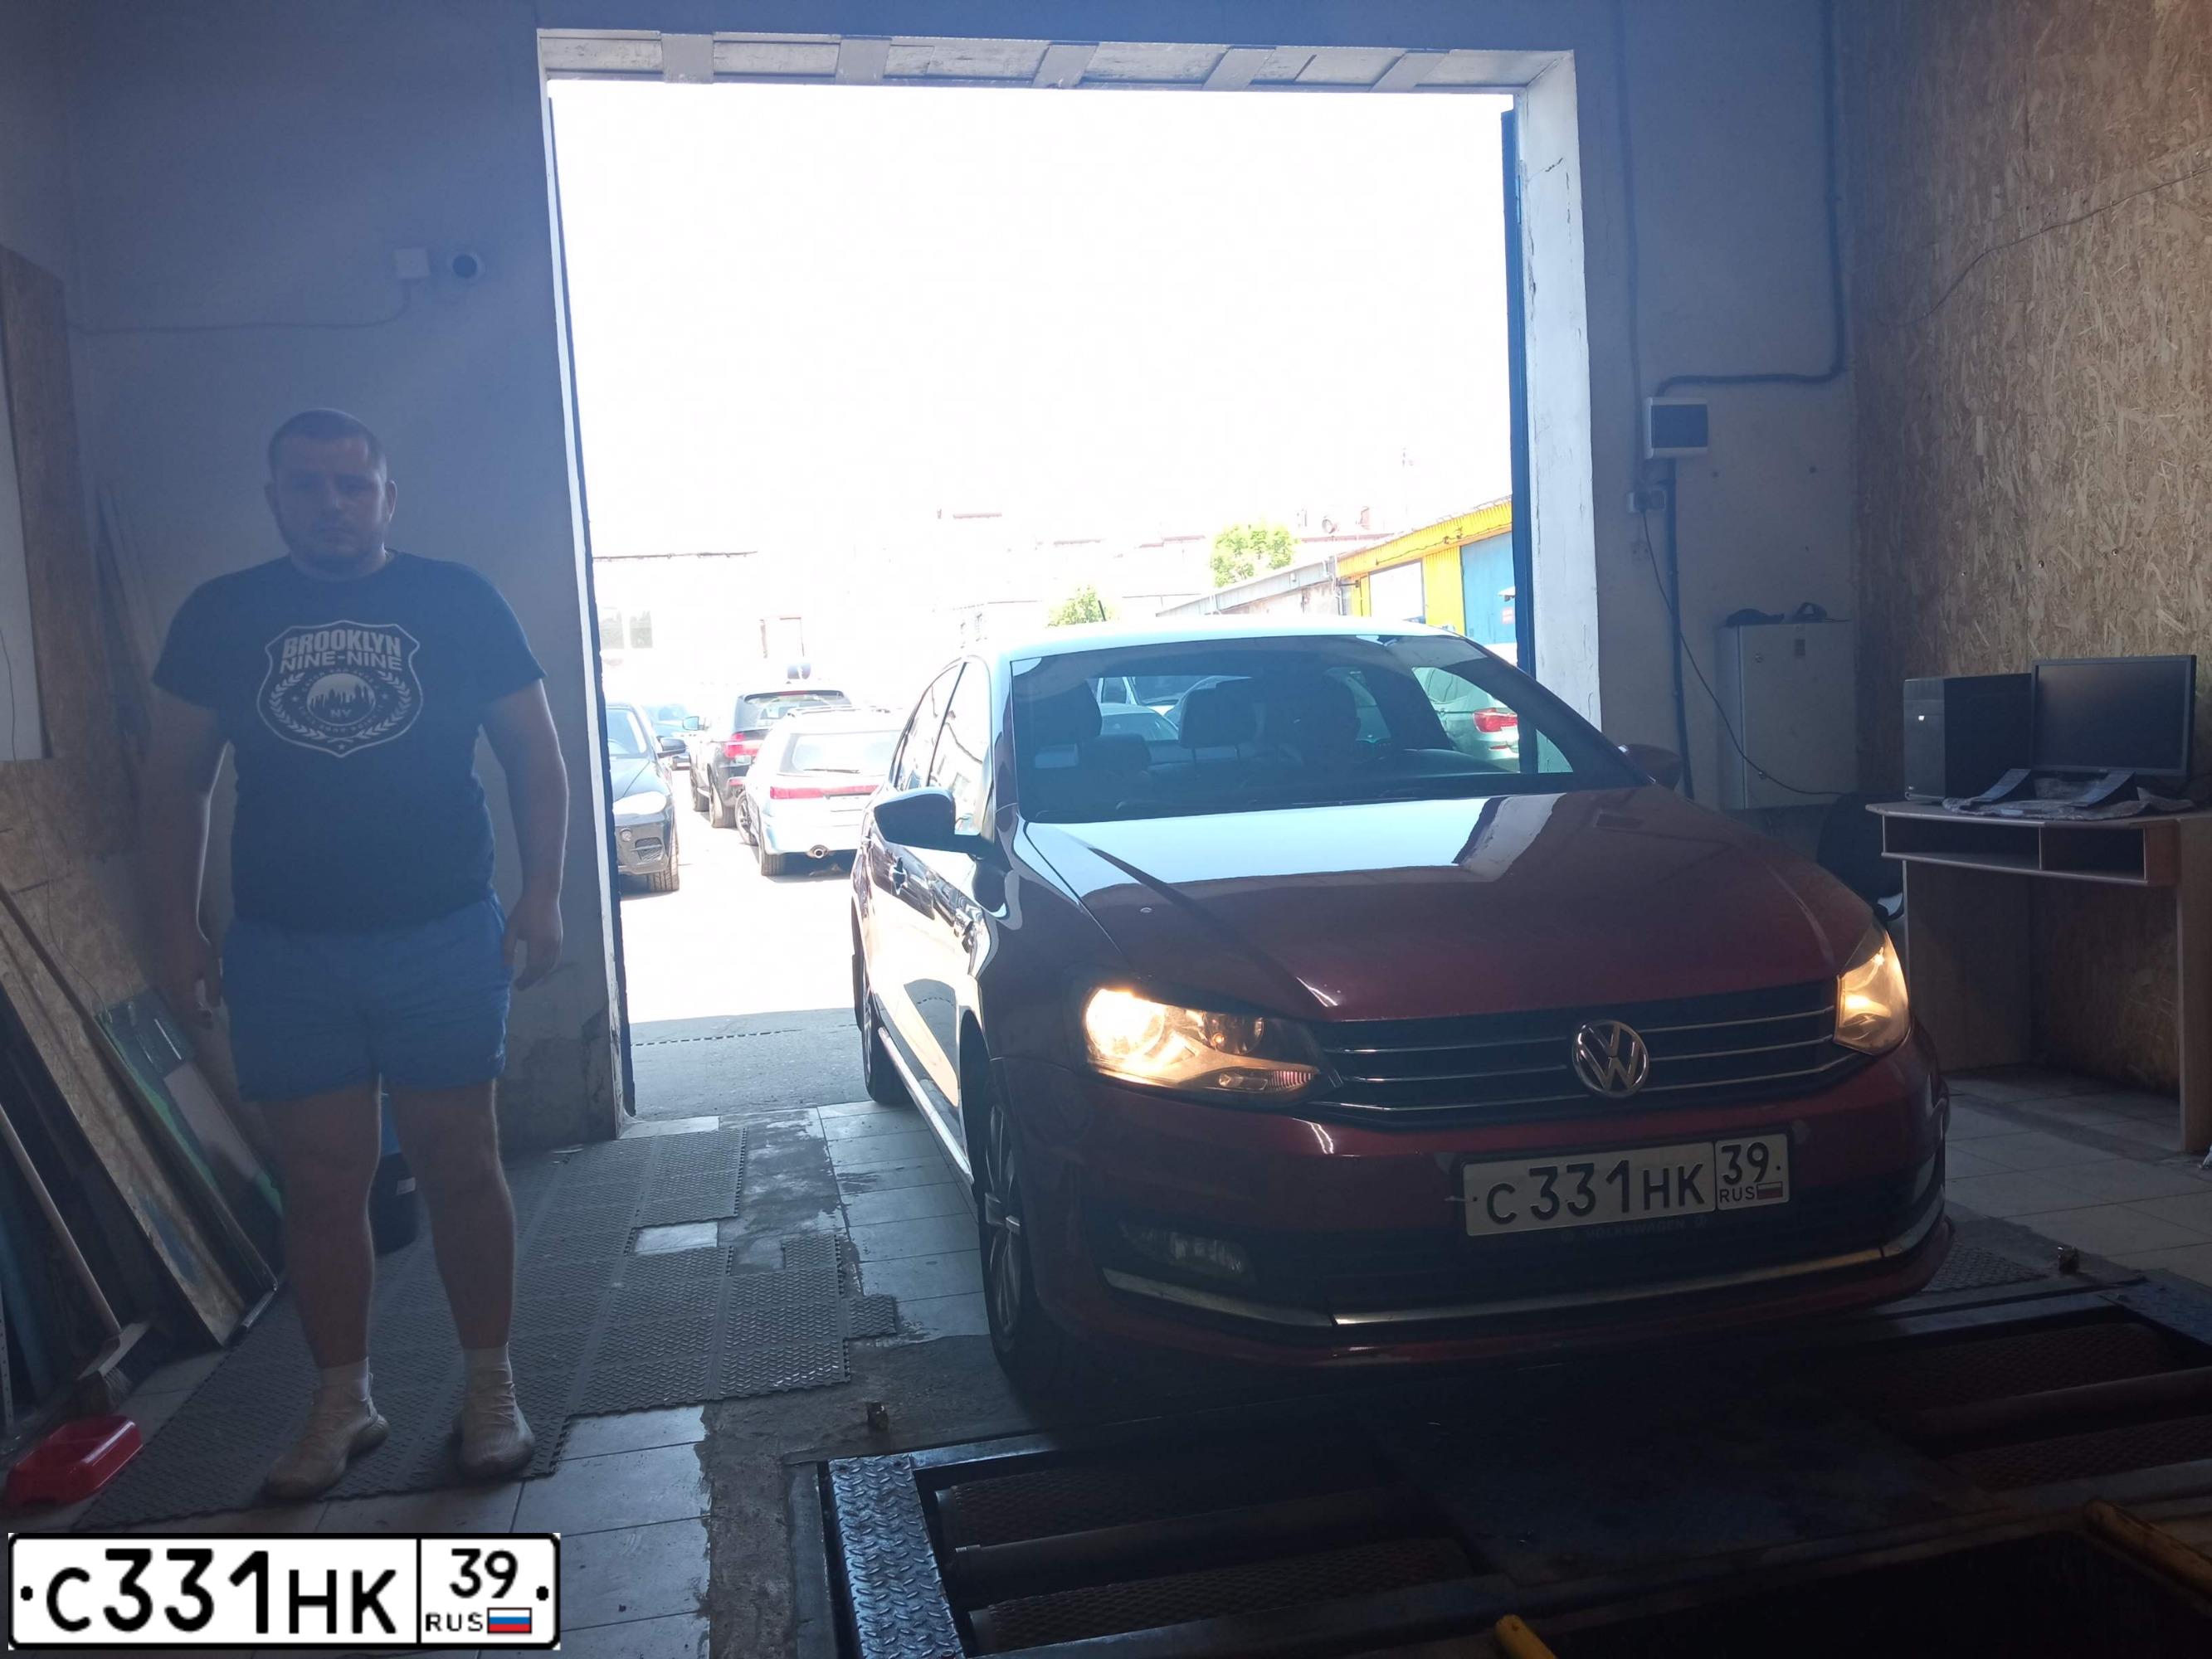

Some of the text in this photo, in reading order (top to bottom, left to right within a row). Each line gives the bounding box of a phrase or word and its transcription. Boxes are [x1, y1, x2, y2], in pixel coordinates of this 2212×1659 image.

[283, 629, 402, 659] BROOKLYN
[279, 650, 402, 674] NINE-NINE
[330, 709, 352, 718] NY
[1721, 1141, 1770, 1184] 39
[1719, 1185, 1756, 1204] RUS
